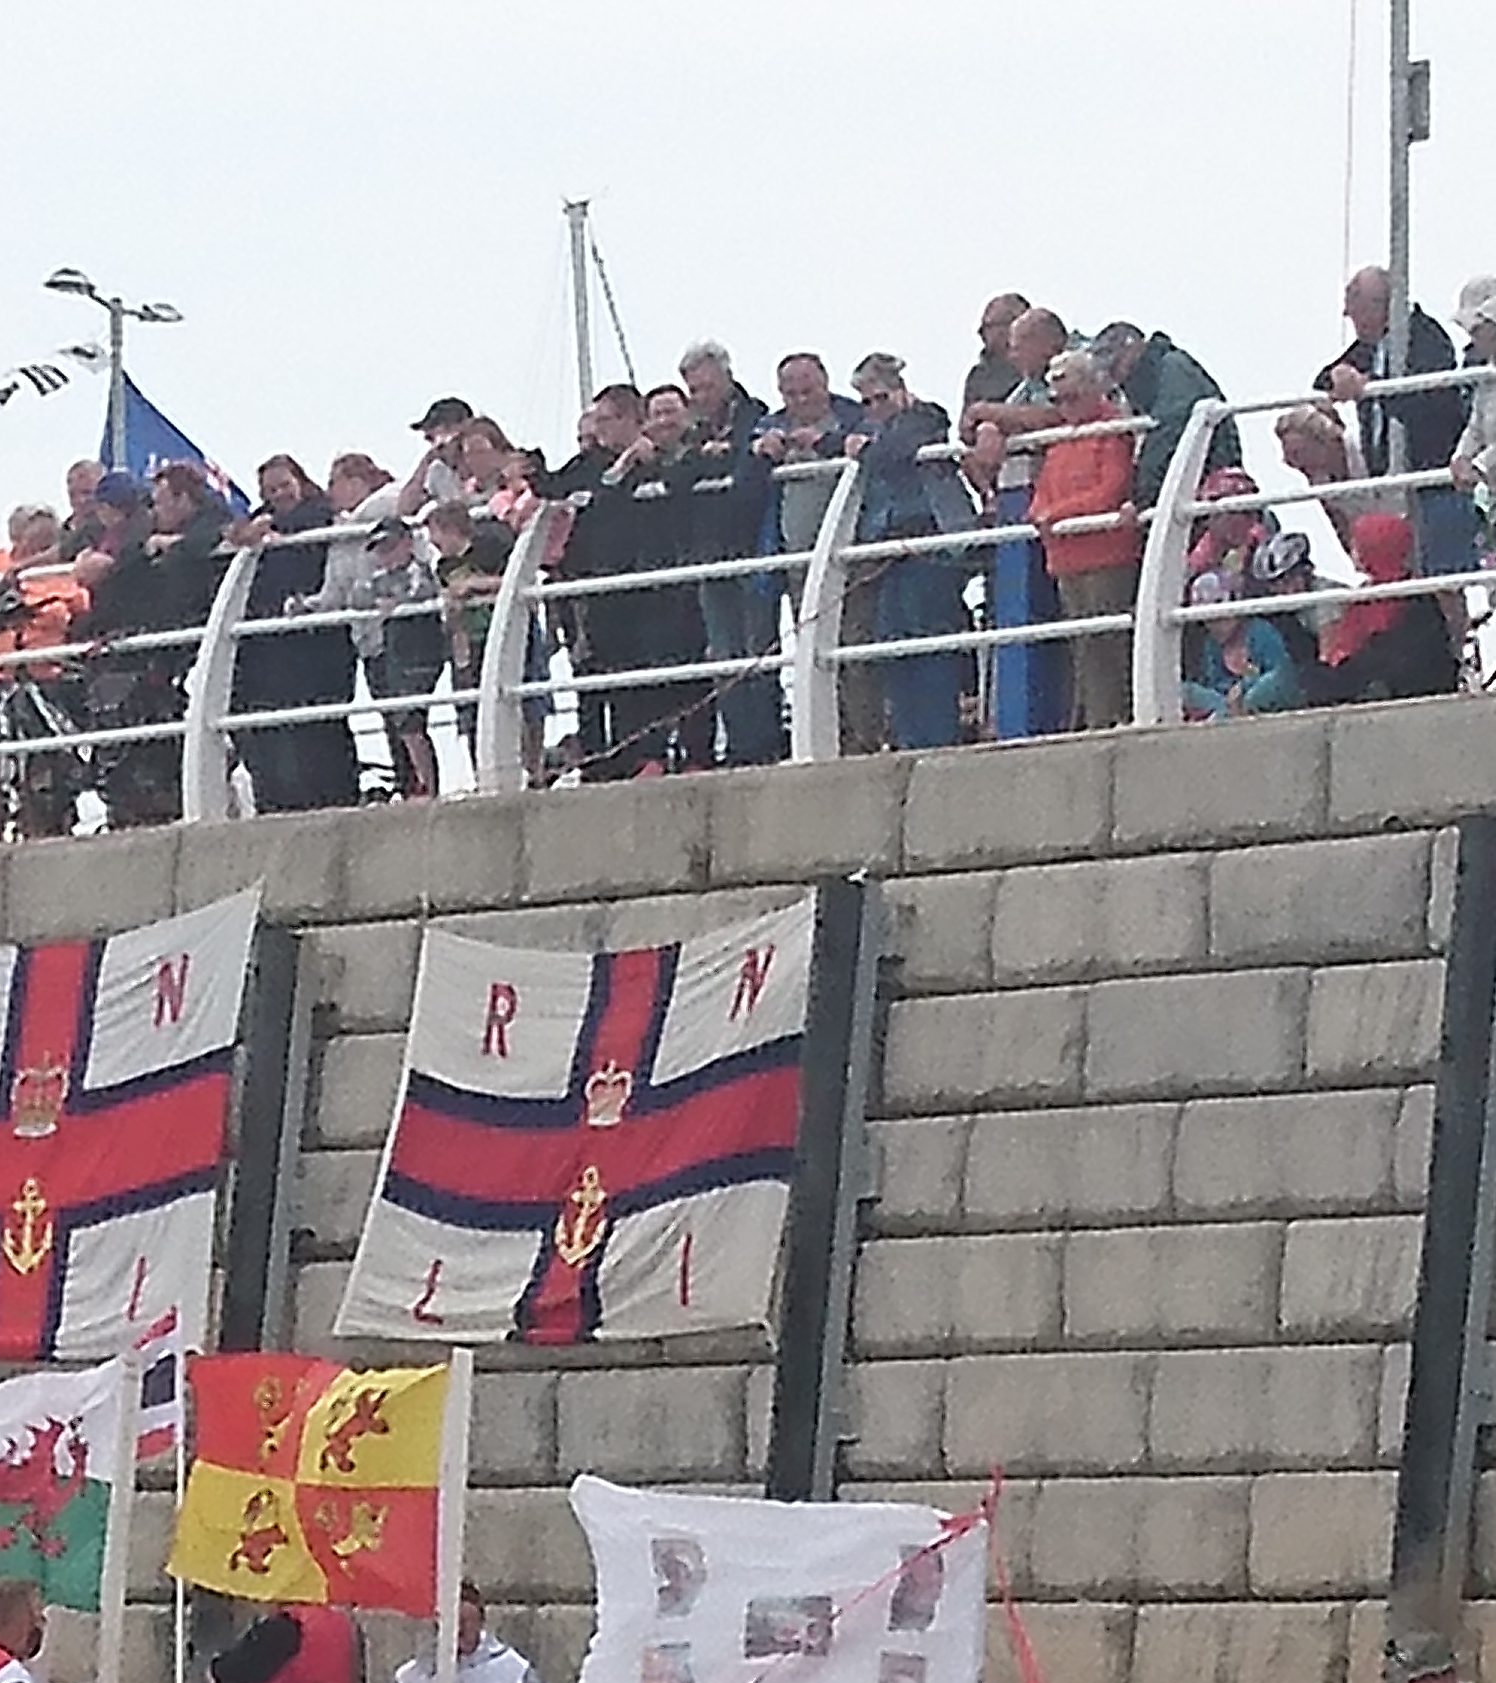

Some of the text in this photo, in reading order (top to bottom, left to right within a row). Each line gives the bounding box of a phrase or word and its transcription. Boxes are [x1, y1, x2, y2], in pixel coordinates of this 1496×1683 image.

[153, 953, 190, 1029] N
[482, 943, 776, 1058] R N
[126, 1256, 148, 1322] I
[409, 1232, 693, 1326] L I
